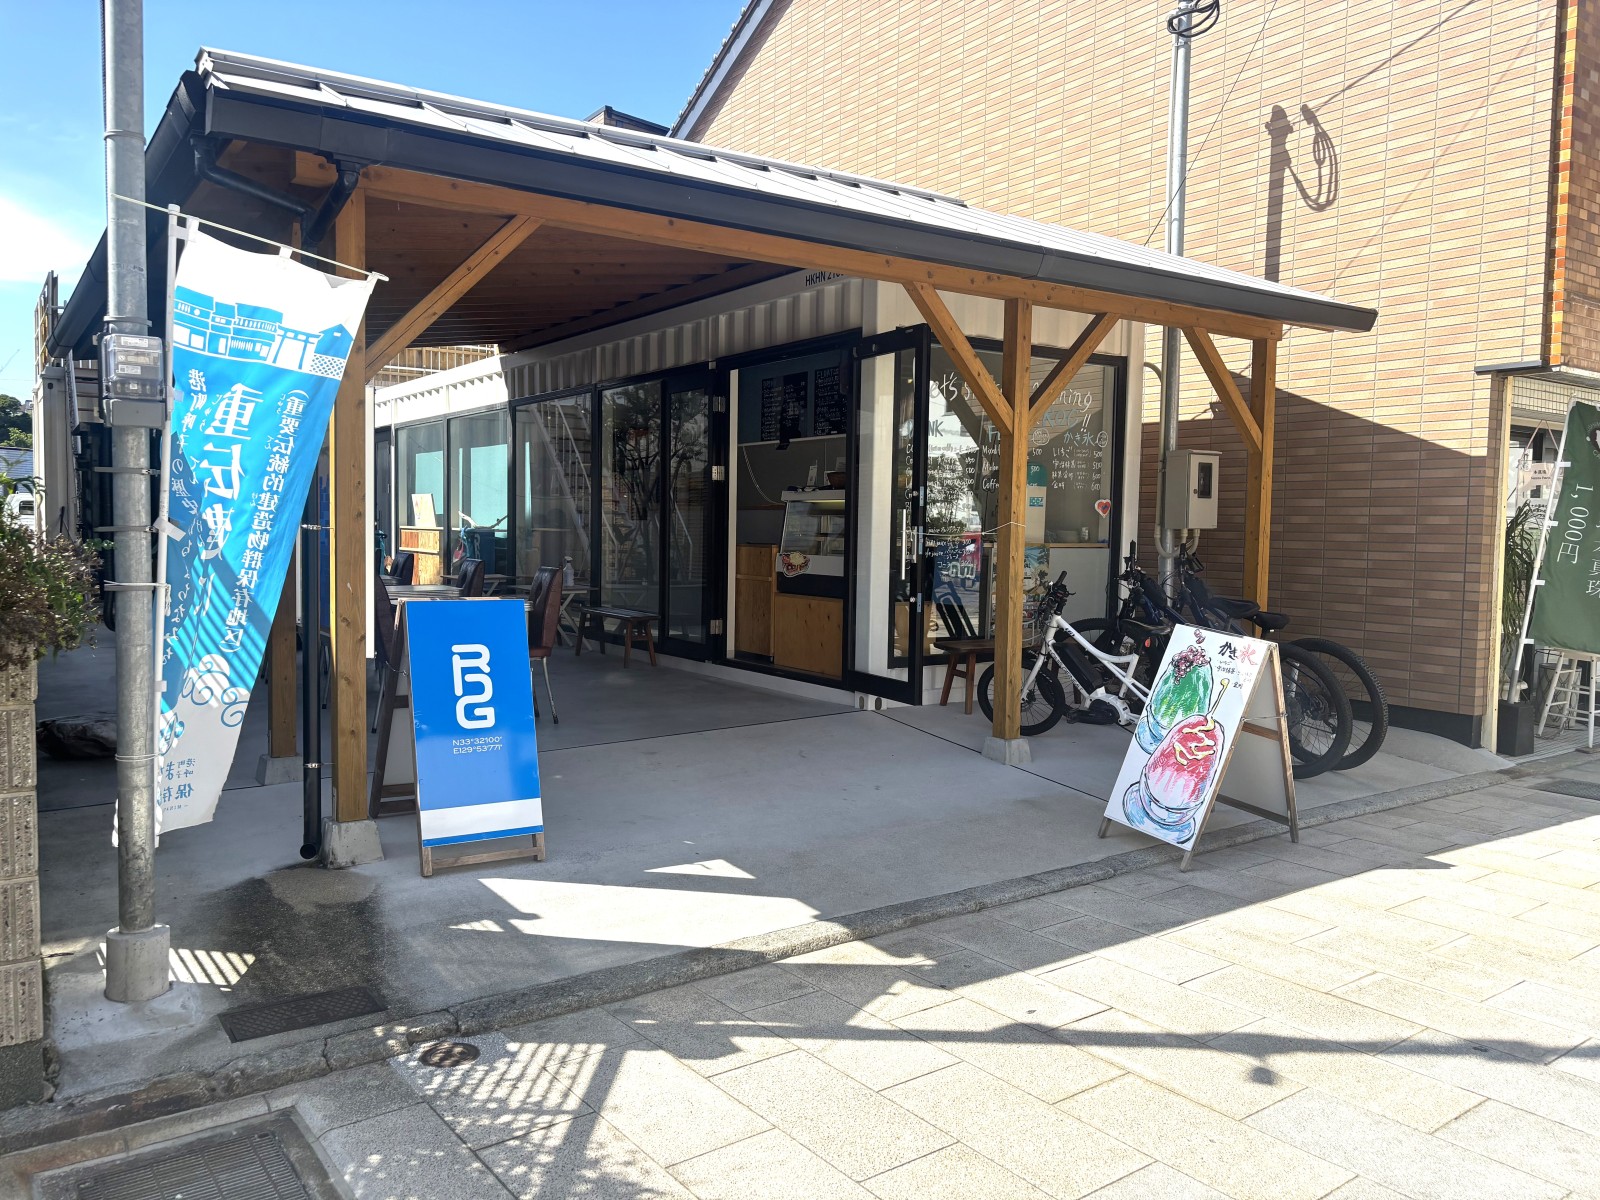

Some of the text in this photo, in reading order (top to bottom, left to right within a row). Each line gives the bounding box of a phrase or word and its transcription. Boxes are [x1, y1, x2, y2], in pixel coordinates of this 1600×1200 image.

[805, 271, 826, 286] HKHN
[1063, 431, 1096, 447] かき氷
[1053, 446, 1073, 458] いちご
